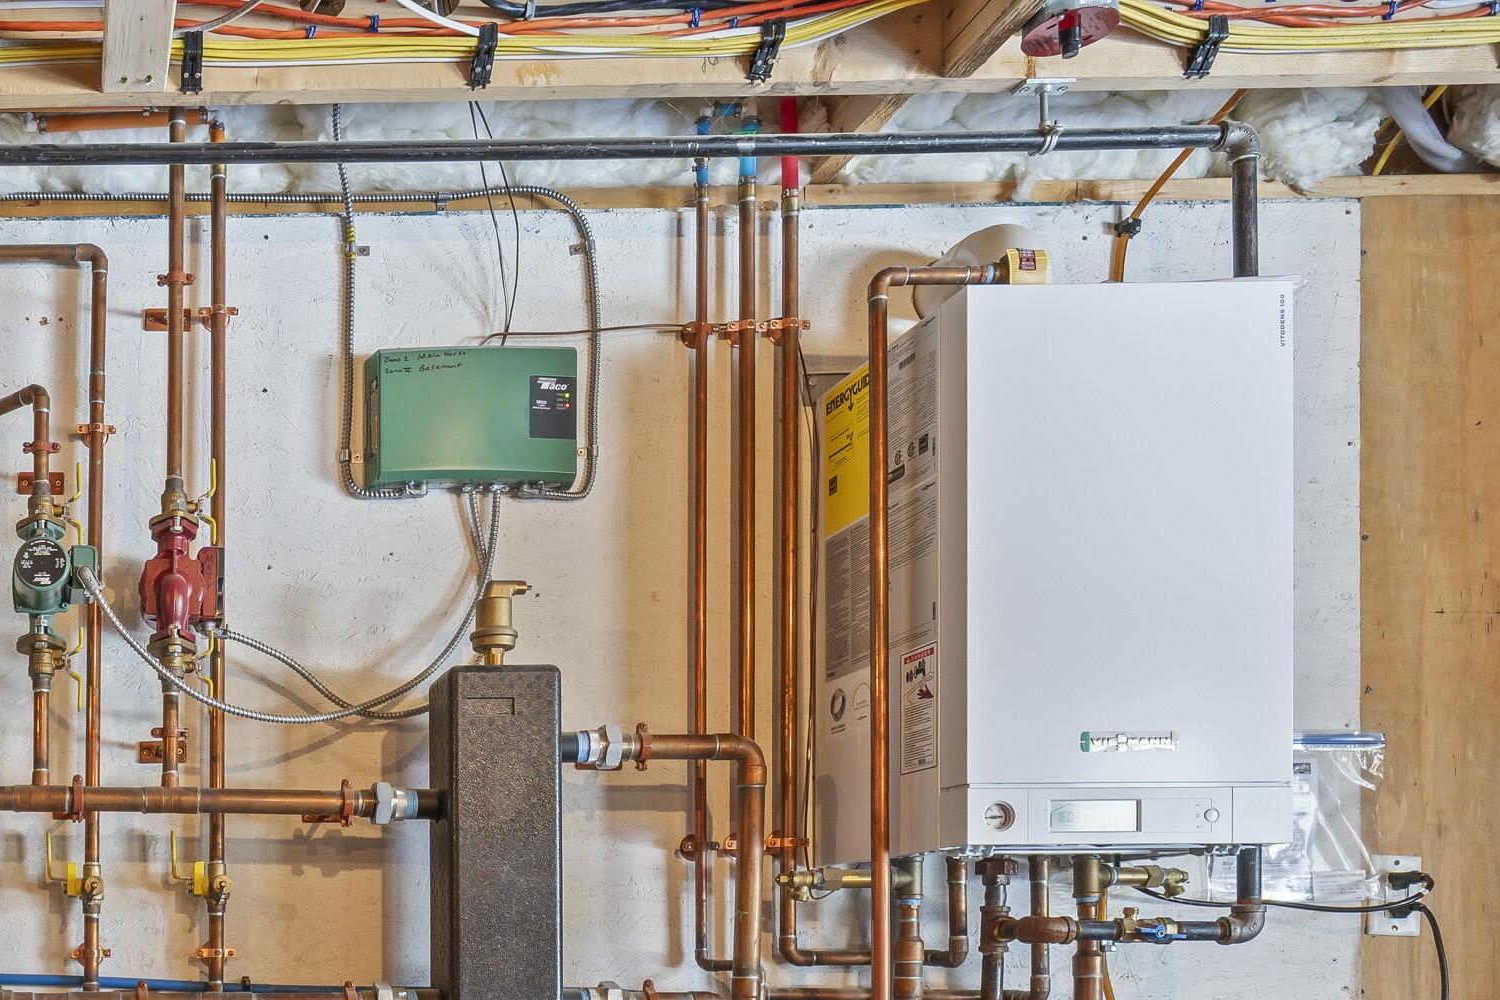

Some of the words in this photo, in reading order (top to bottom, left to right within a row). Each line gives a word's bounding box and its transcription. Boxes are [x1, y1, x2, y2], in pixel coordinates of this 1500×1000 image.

[417, 352, 440, 361] Main
[418, 362, 463, 373] Basement
[536, 377, 567, 391] Taco
